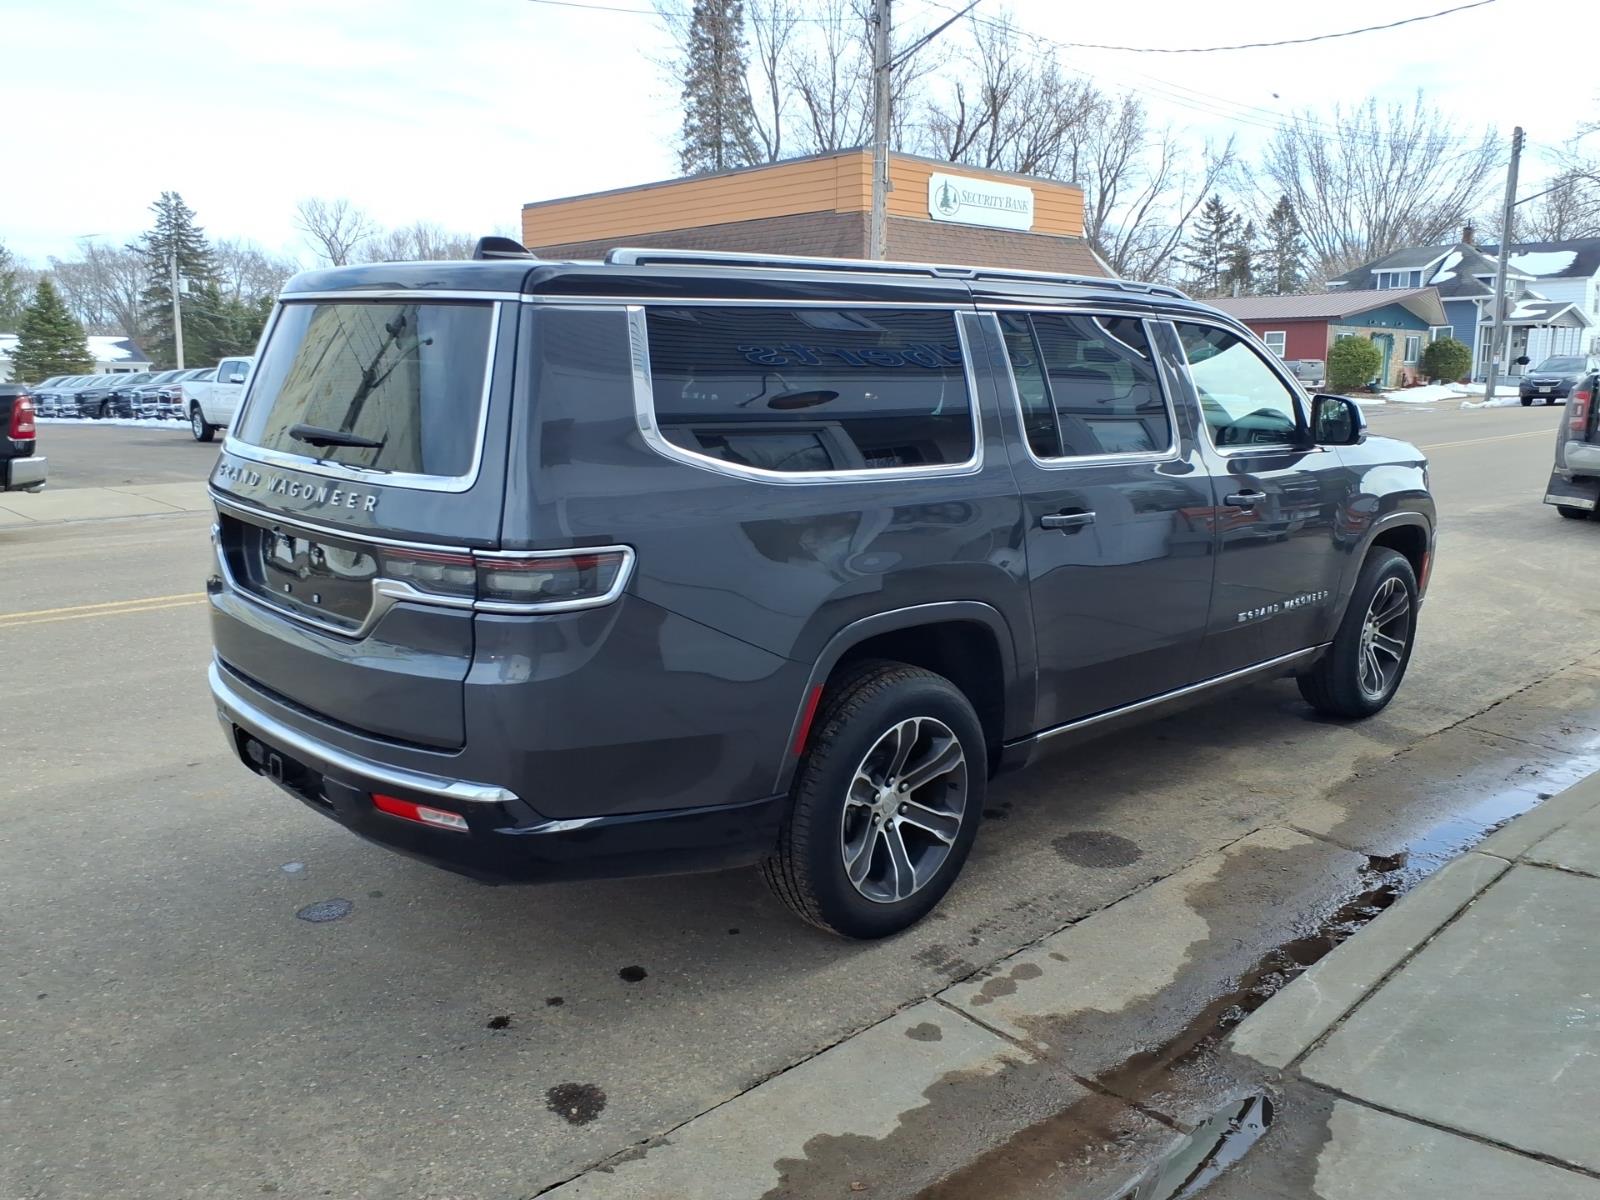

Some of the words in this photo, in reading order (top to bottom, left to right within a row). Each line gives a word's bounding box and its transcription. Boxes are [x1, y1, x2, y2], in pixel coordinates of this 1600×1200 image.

[961, 190, 1005, 208] SECURITY
[1005, 196, 1029, 211] BANK
[219, 463, 260, 487] GRAND
[266, 477, 379, 512] WAGONEER
[1246, 603, 1279, 619] GRAND
[1283, 590, 1329, 609] WAGONEER
